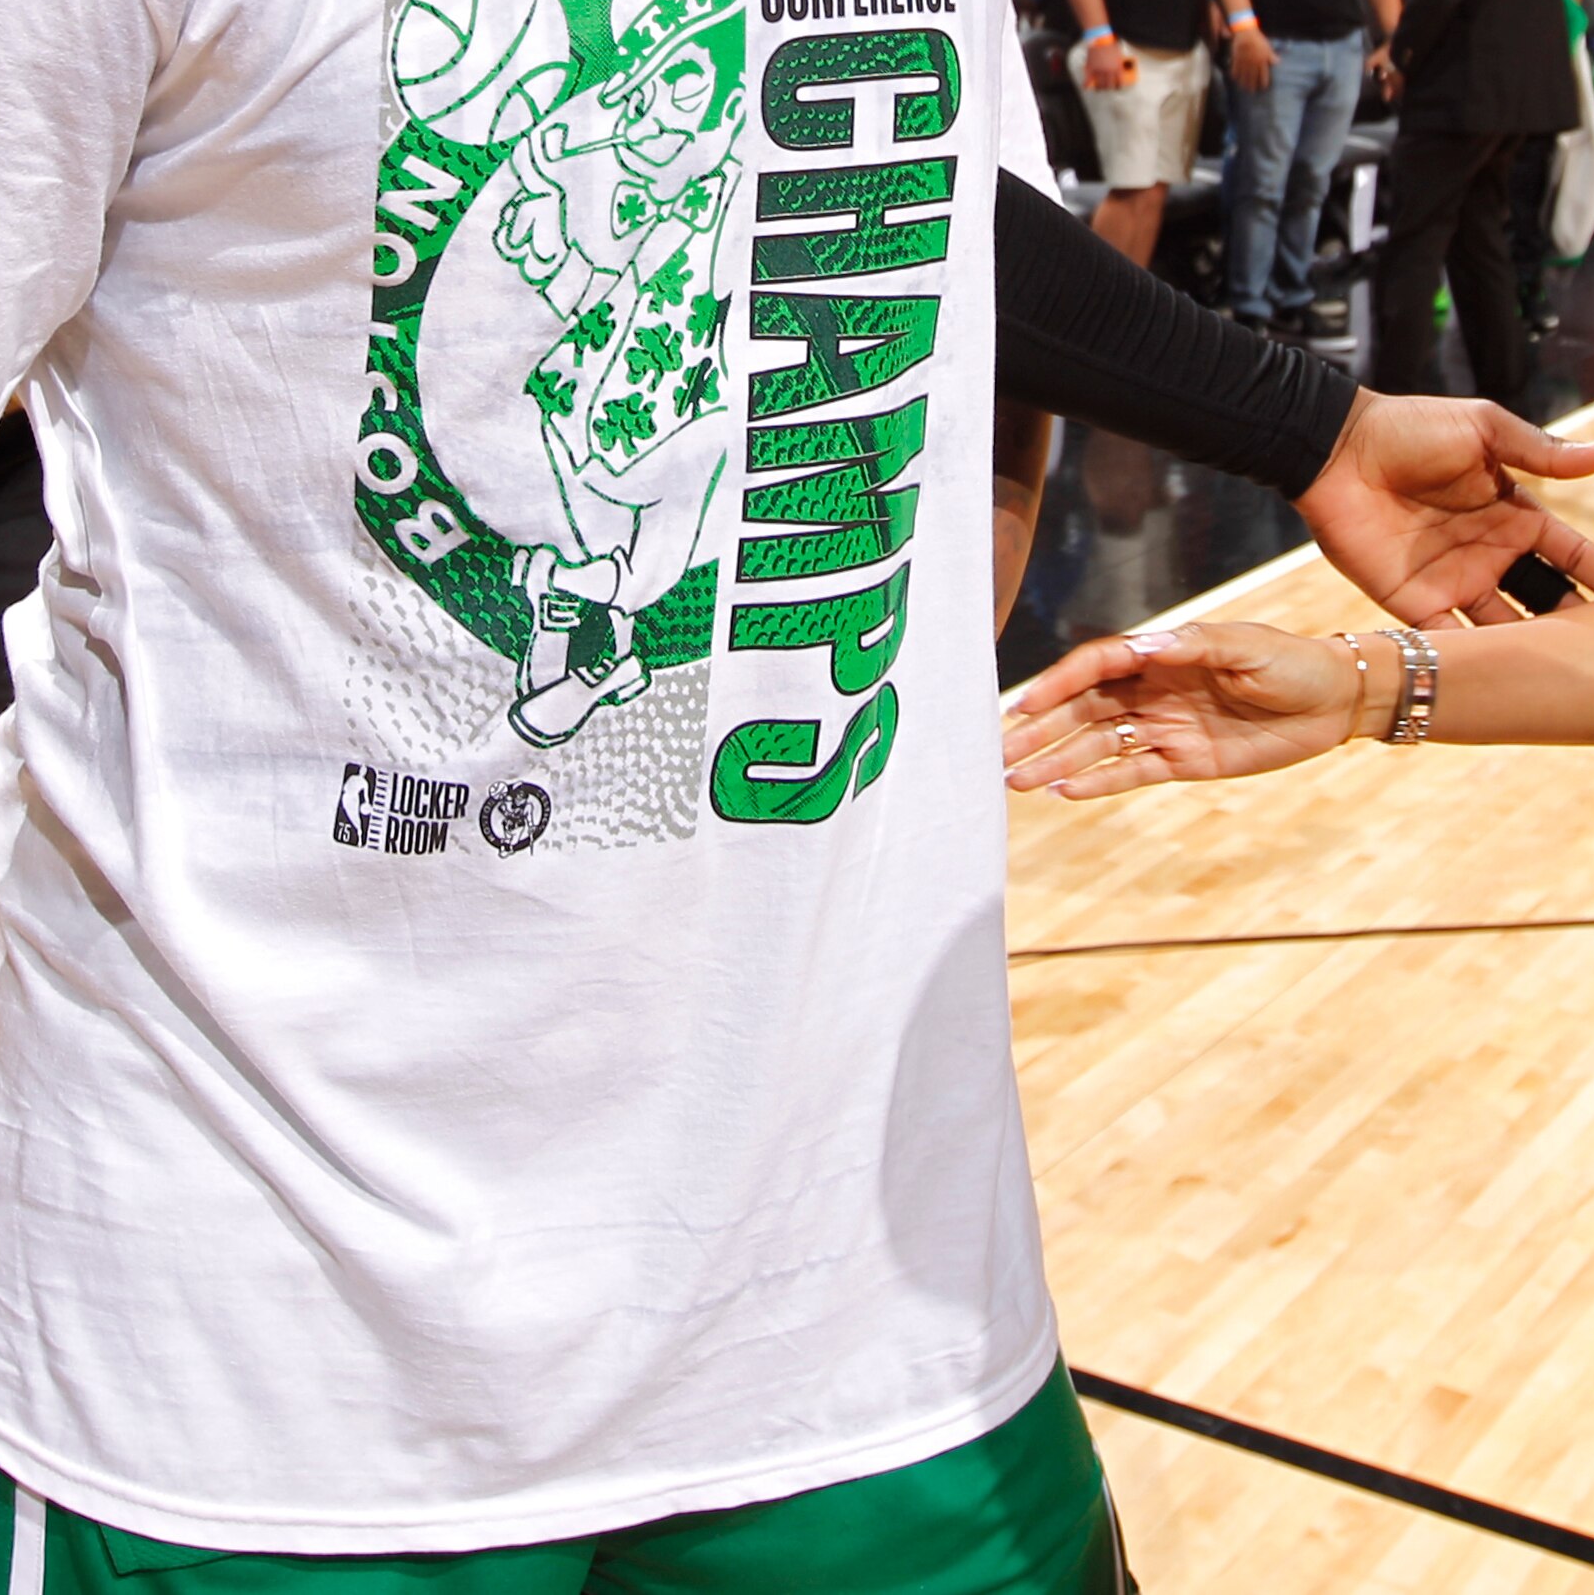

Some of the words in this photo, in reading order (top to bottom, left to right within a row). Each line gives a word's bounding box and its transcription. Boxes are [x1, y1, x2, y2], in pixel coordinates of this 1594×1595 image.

[710, 28, 961, 824] CHAMPS
[390, 772, 470, 820] LOCKER
[336, 821, 352, 843] 75
[385, 816, 449, 855] ROOM
